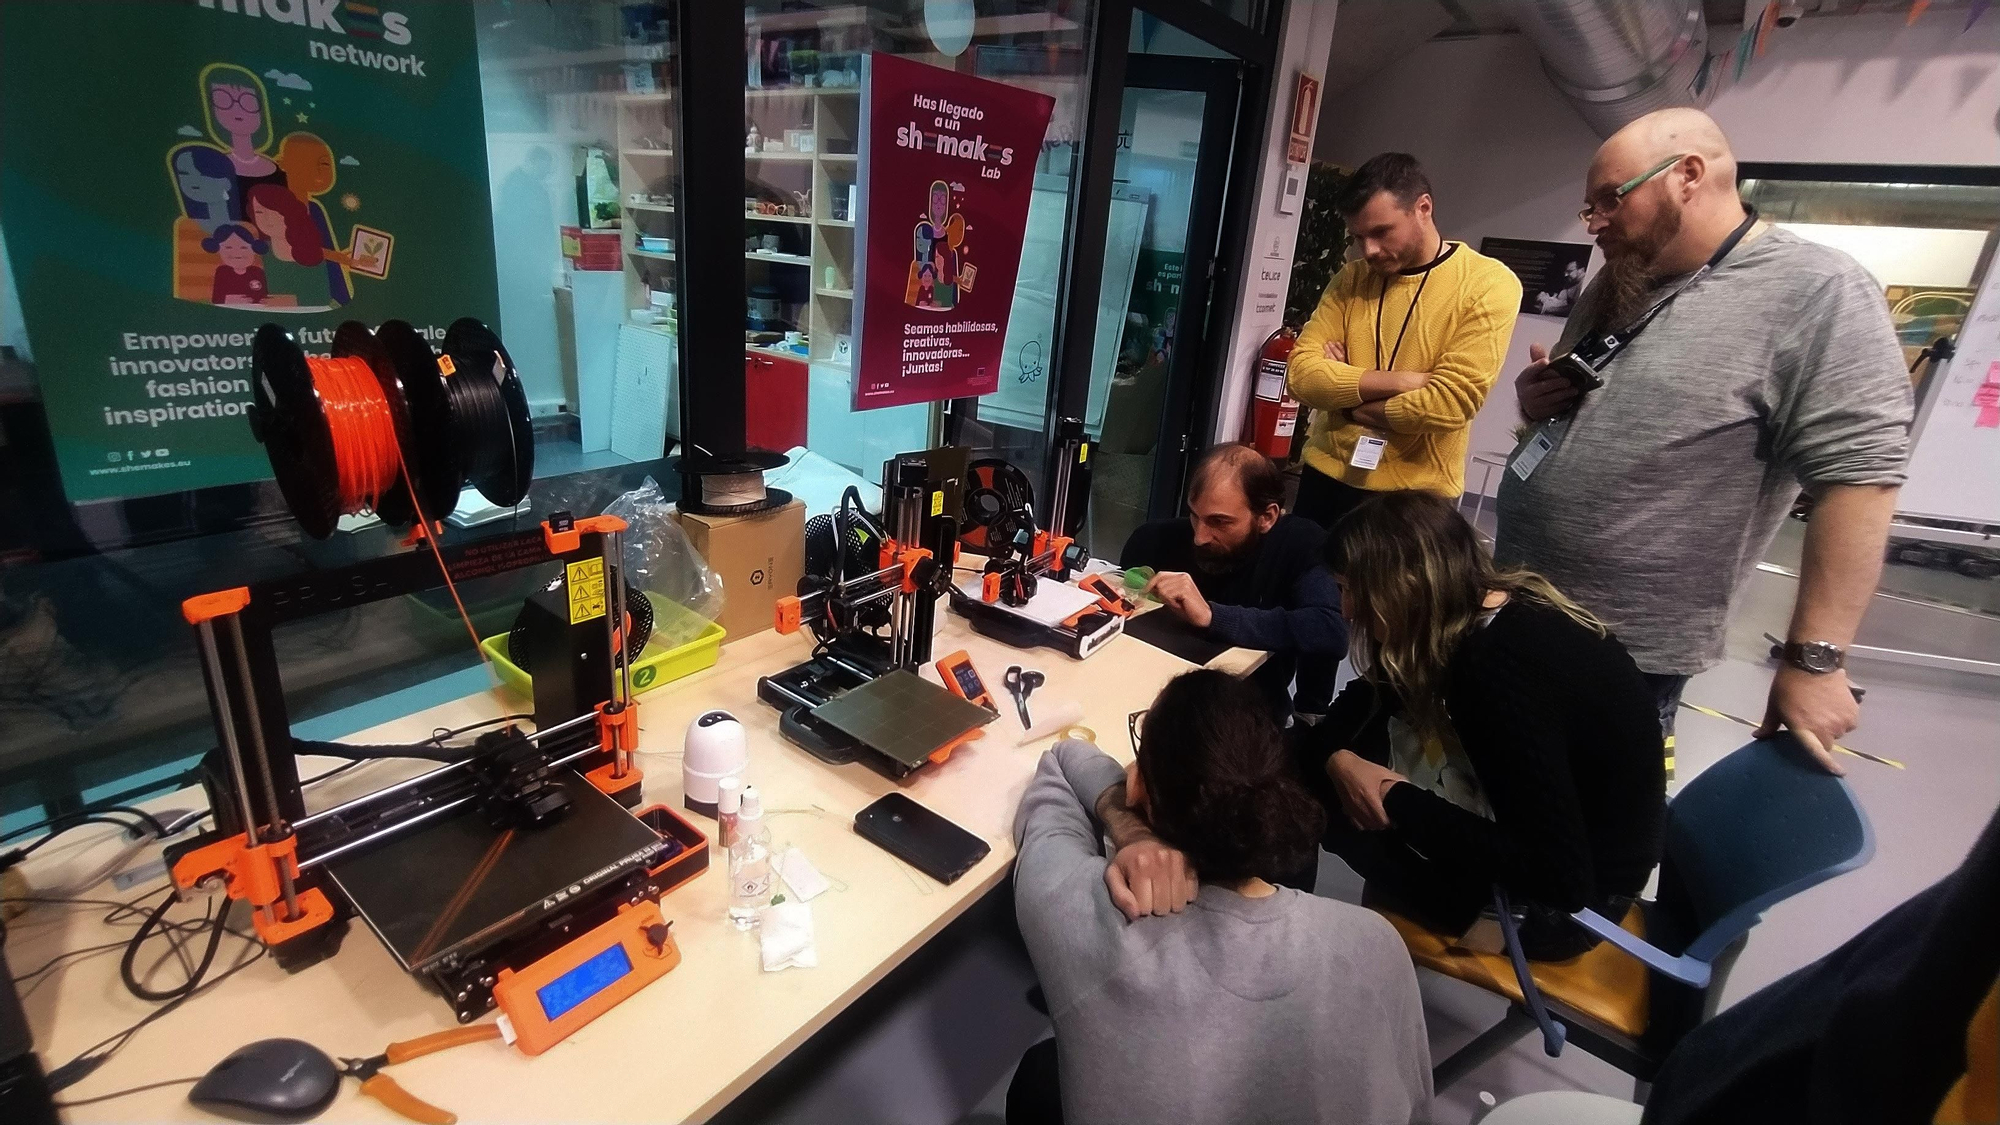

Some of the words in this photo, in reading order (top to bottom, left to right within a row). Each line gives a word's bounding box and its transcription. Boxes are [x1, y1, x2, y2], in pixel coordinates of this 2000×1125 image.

[309, 40, 427, 77] network
[913, 93, 937, 111] Has
[939, 99, 984, 121] llegado
[934, 116, 943, 127] a
[945, 118, 961, 131] un
[981, 165, 1001, 180] Lab
[904, 323, 944, 335] Seamos
[945, 321, 999, 333] habilidosas,
[123, 328, 259, 354] Empower
[298, 326, 336, 344] fut
[903, 335, 952, 348] creativas,
[902, 348, 971, 362] innovadoras...
[902, 360, 944, 377] ¡Juntas!
[146, 376, 250, 398] fashion
[640, 669, 651, 685] 2
[583, 864, 620, 885] ORIGINAL
